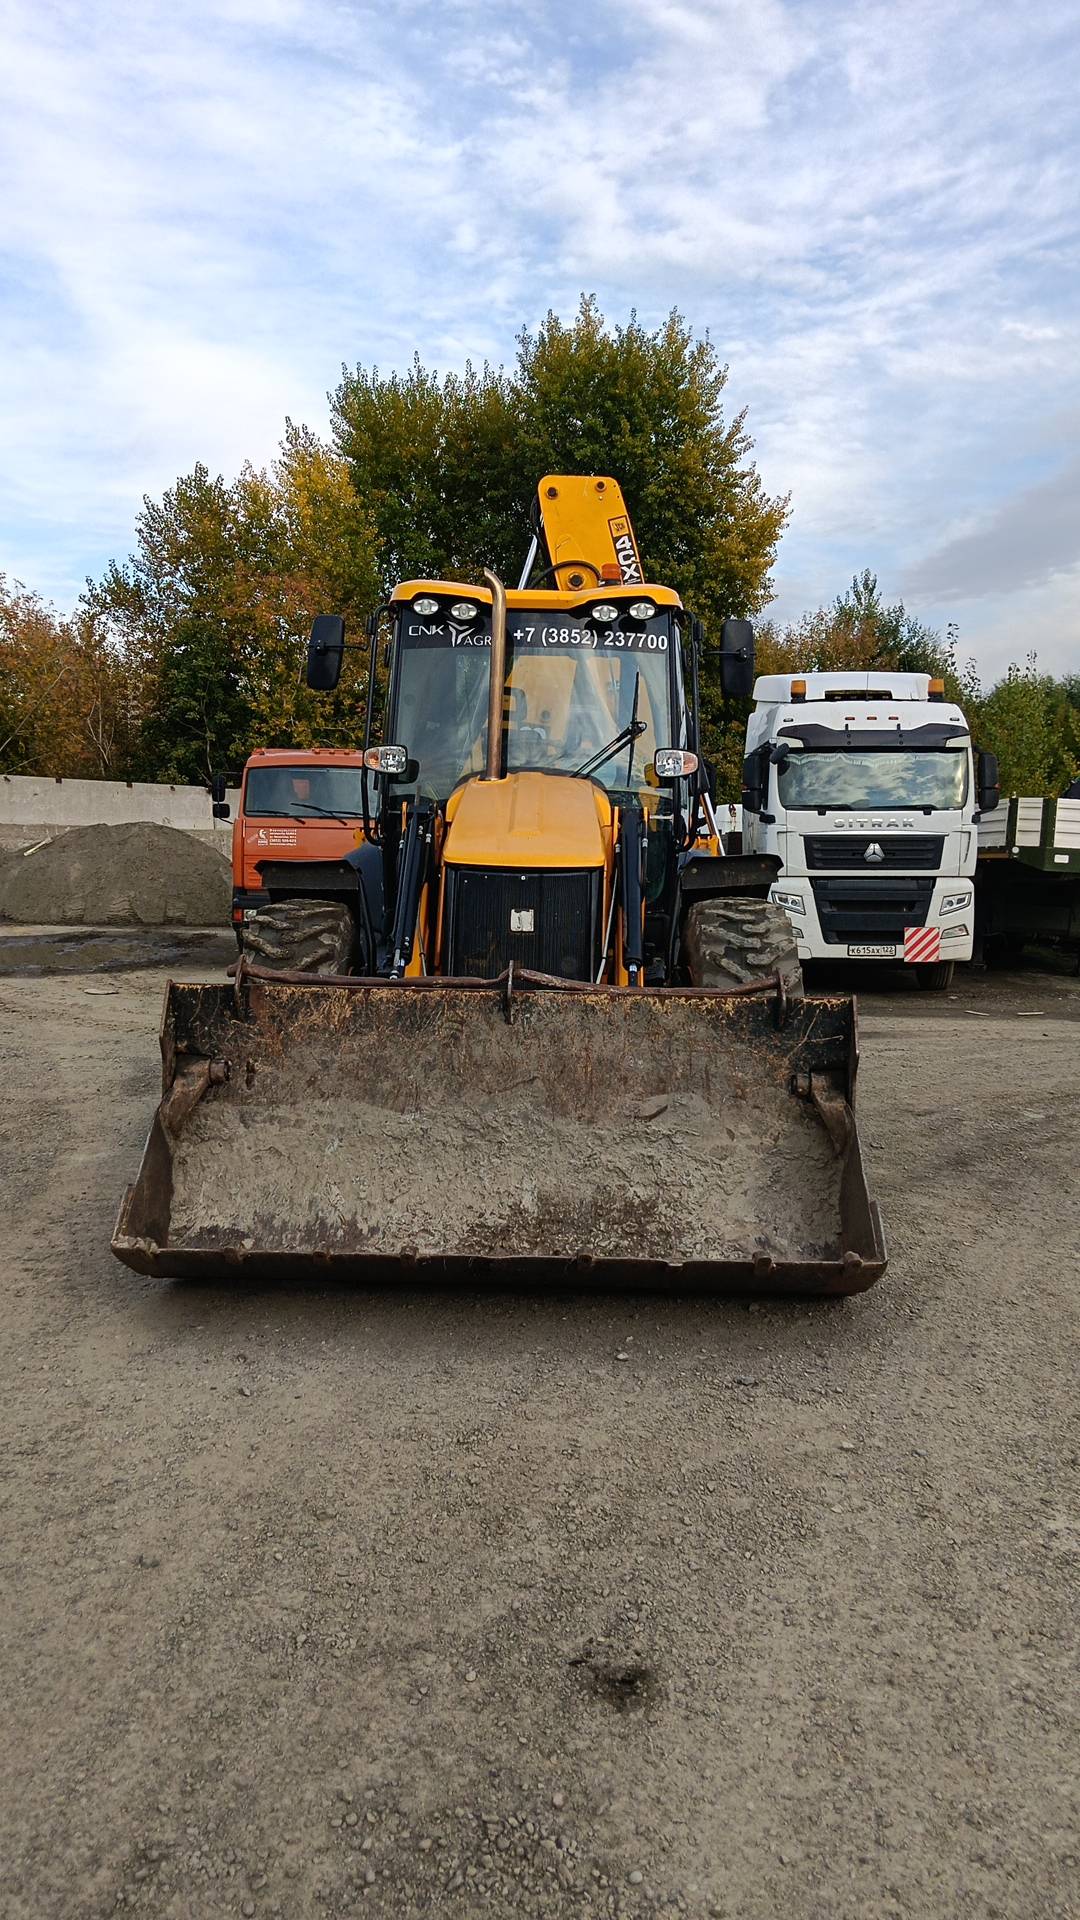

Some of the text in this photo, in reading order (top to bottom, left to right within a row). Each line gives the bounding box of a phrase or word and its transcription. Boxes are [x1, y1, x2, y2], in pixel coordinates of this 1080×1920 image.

[615, 535, 640, 580] 4CX
[463, 634, 493, 647] AGR
[513, 627, 668, 650] +7 (3852) 237700
[834, 818, 915, 828] SITRAK
